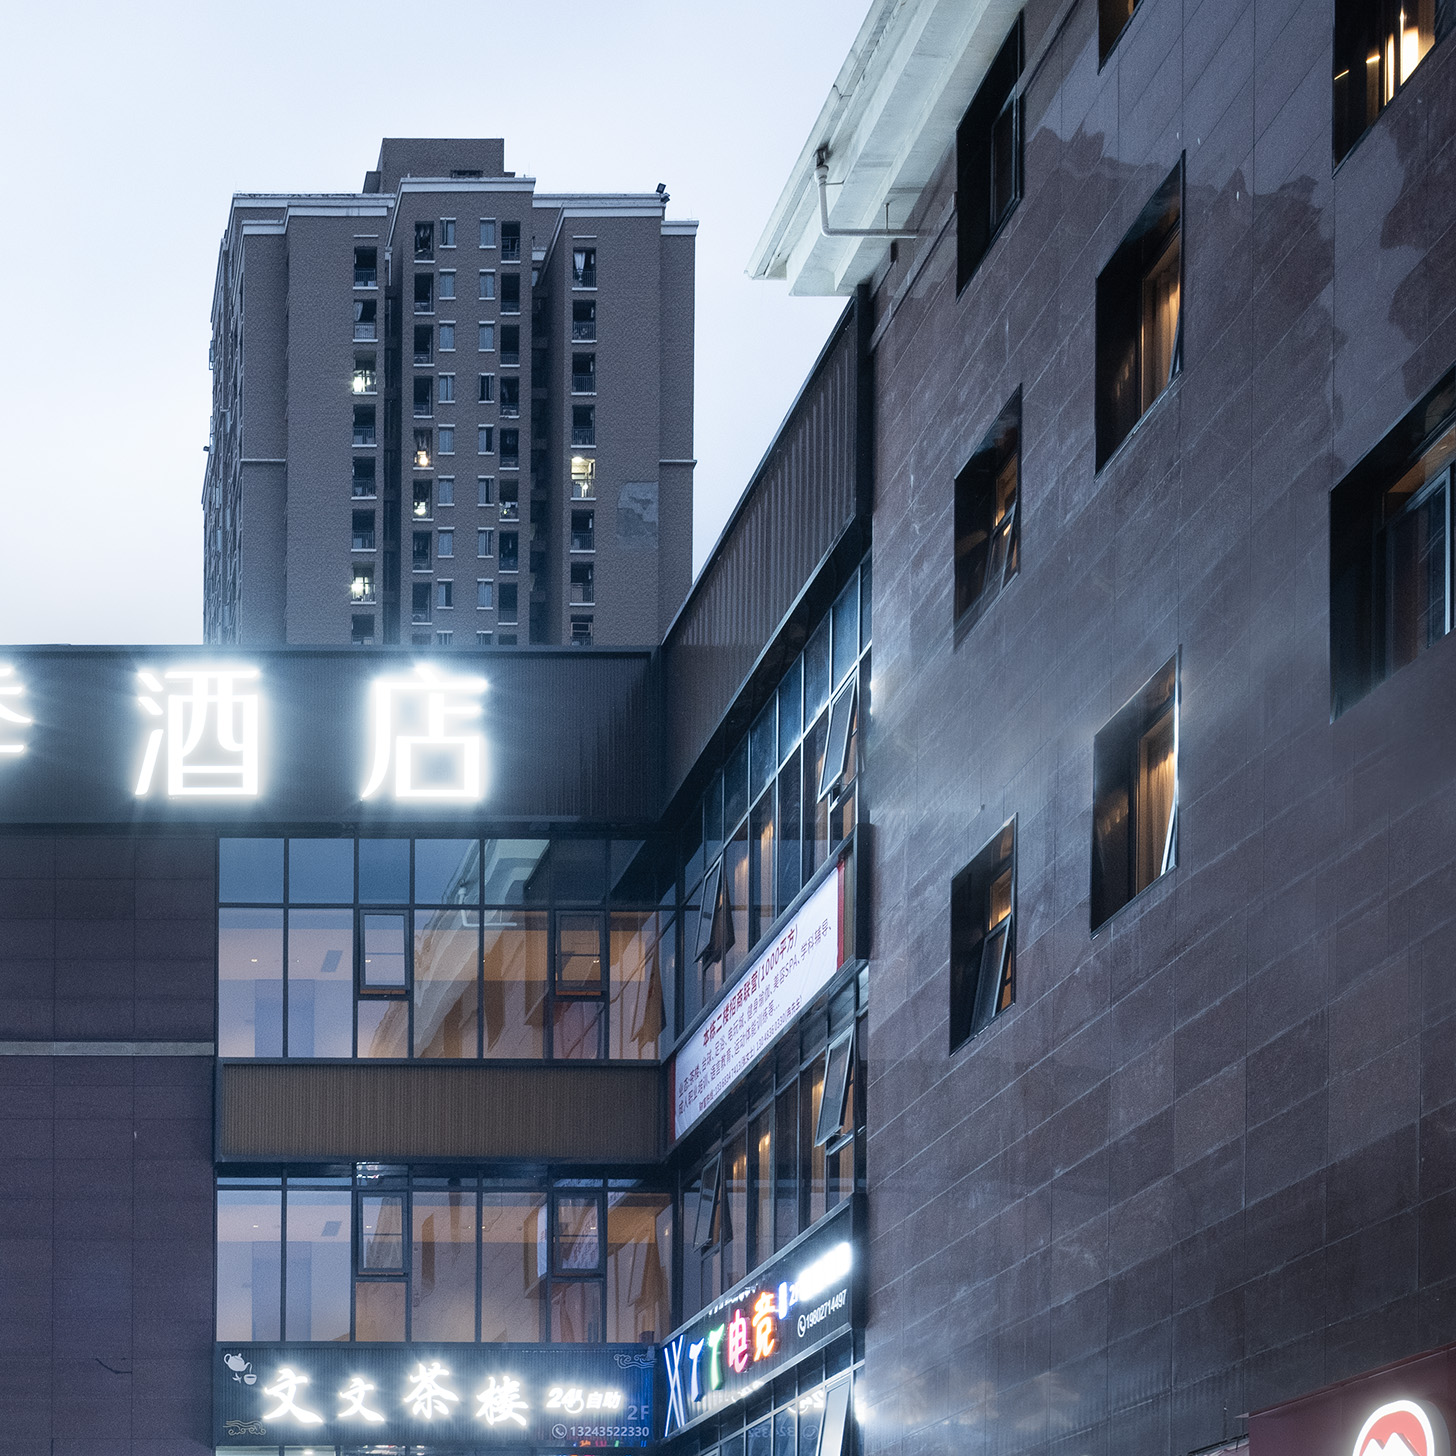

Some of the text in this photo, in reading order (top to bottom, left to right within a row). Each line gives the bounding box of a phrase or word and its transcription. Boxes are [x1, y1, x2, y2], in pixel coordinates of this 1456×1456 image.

[263, 1363, 529, 1426] 文文茶楼
[627, 1405, 650, 1420] 2F
[570, 1426, 650, 1437] 13243522330
